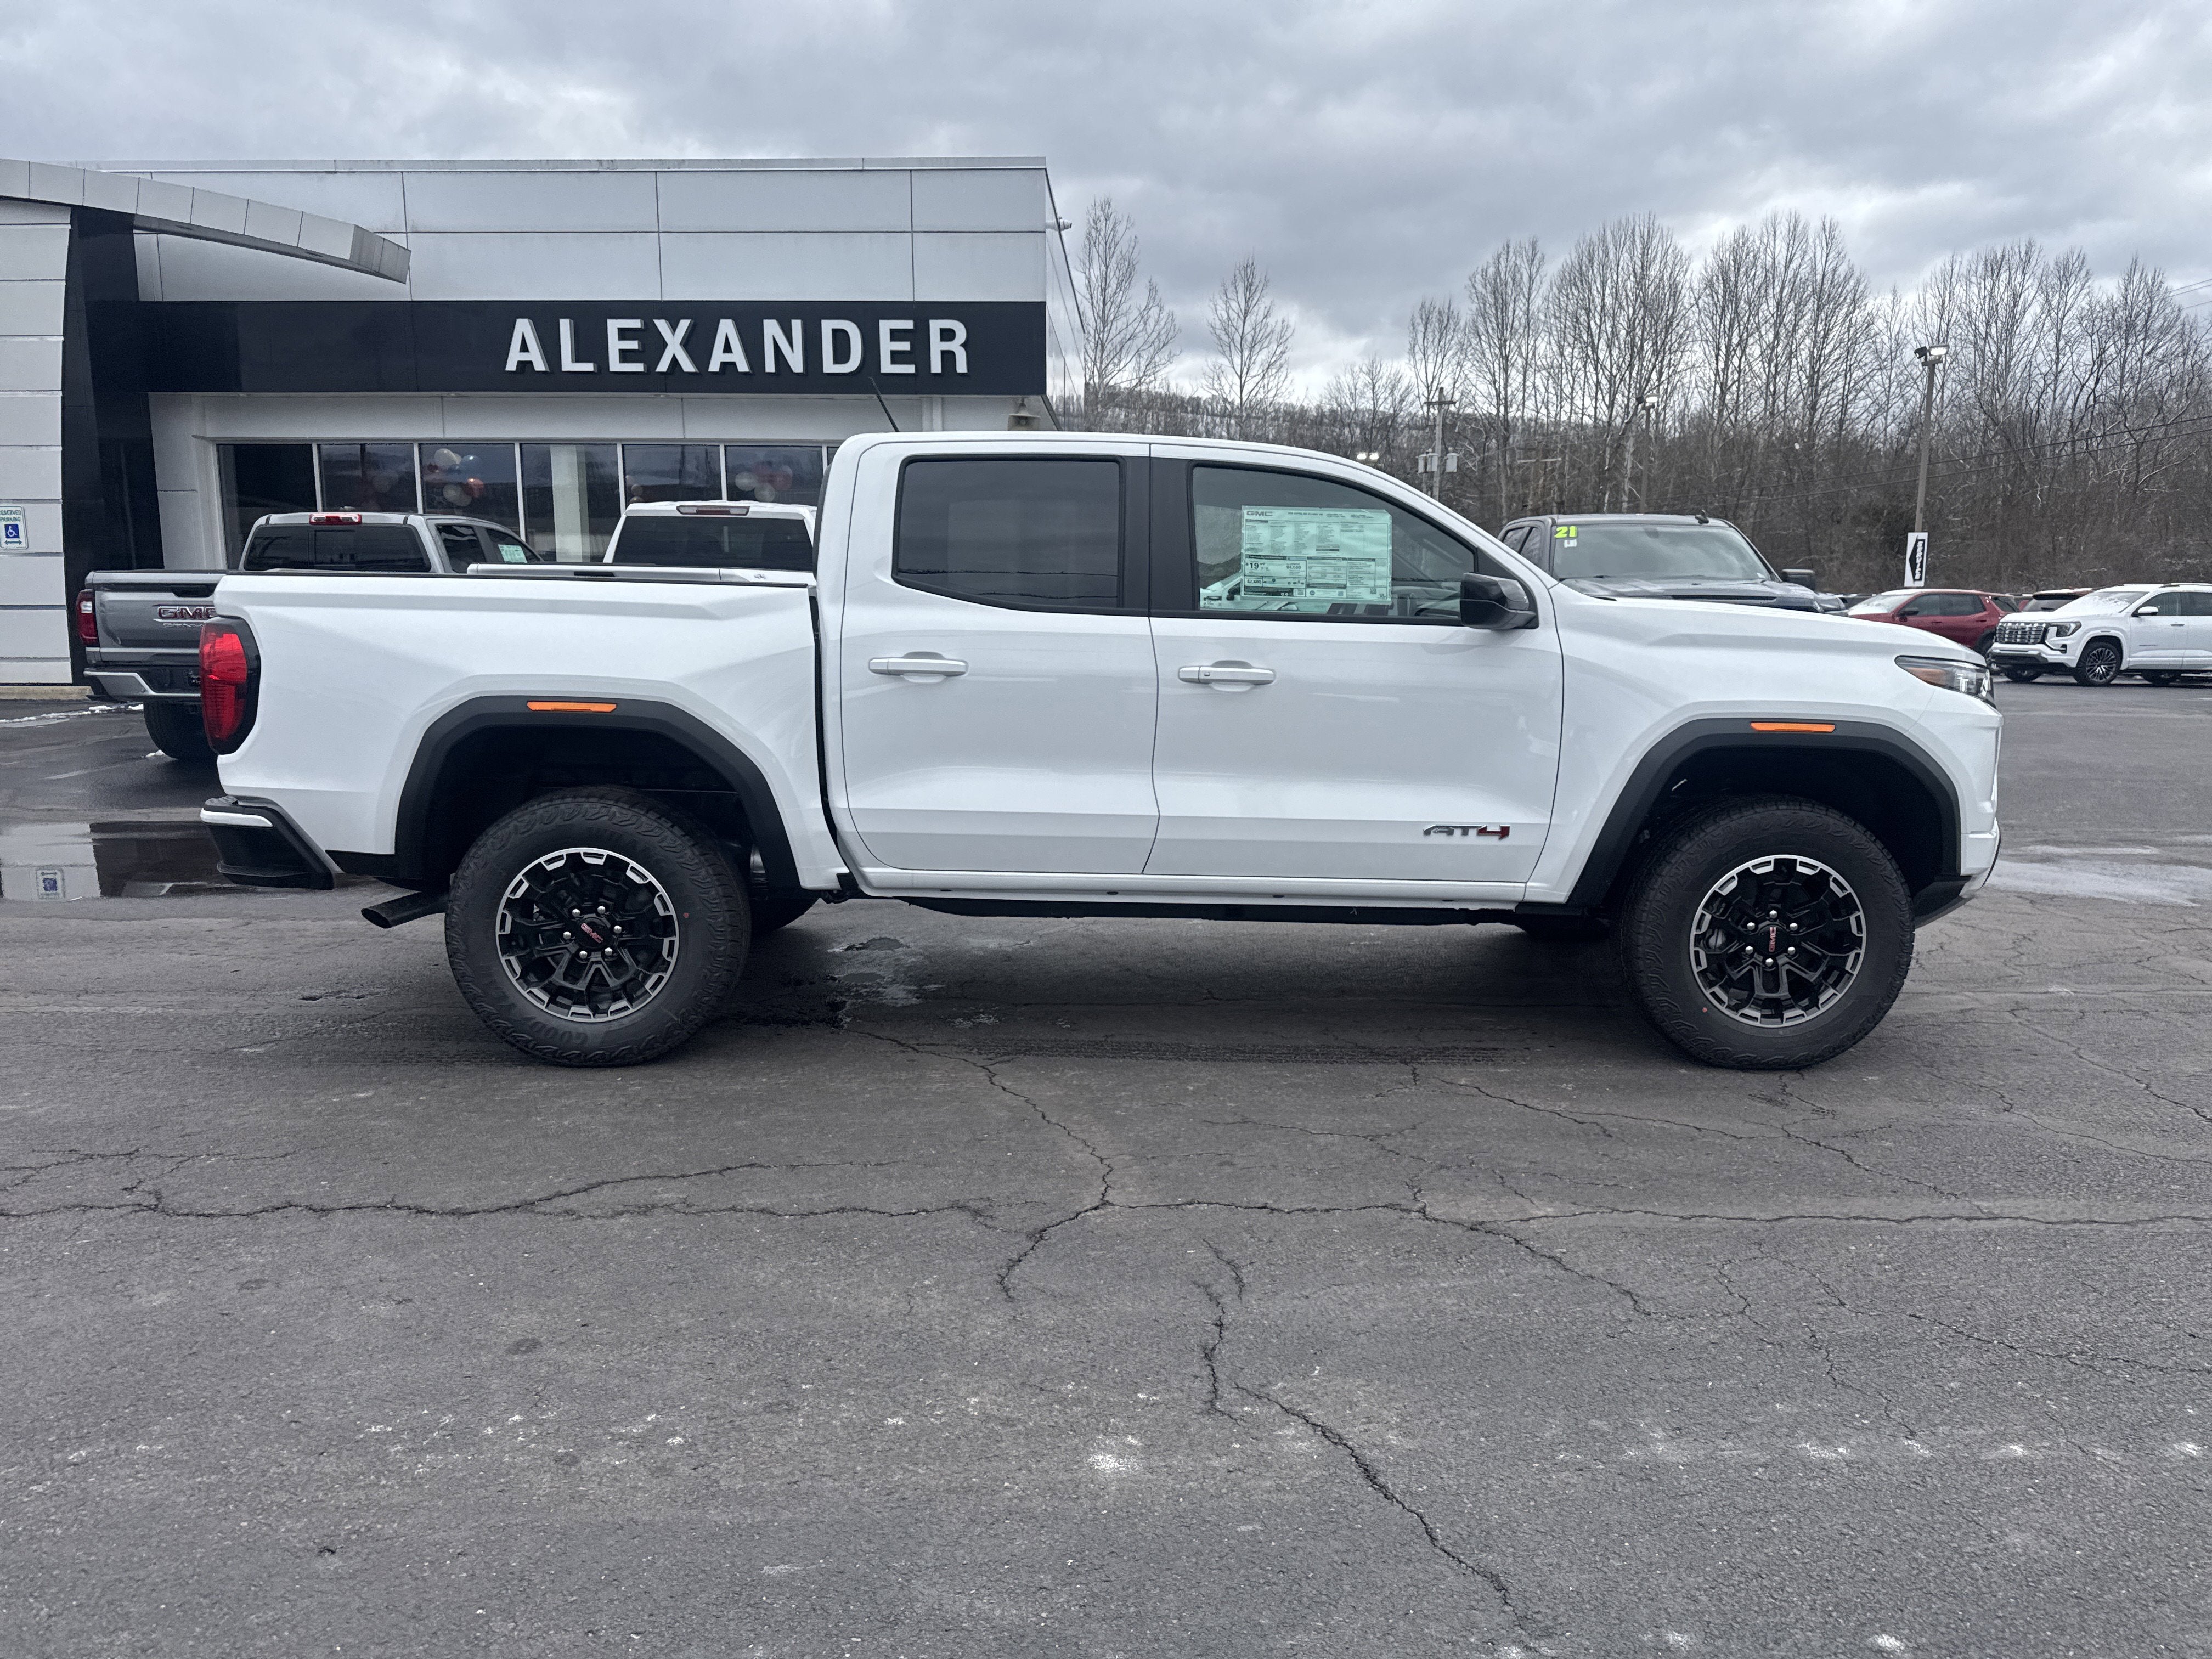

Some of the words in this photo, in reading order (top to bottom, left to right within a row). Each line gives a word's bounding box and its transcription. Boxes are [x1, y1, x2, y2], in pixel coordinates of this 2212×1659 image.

[504, 318, 969, 375] ALEXANDER
[1554, 526, 1577, 538] 21
[1914, 540, 1923, 580] SERVICE
[1424, 824, 1510, 840] AT4
[581, 923, 603, 944] GMC
